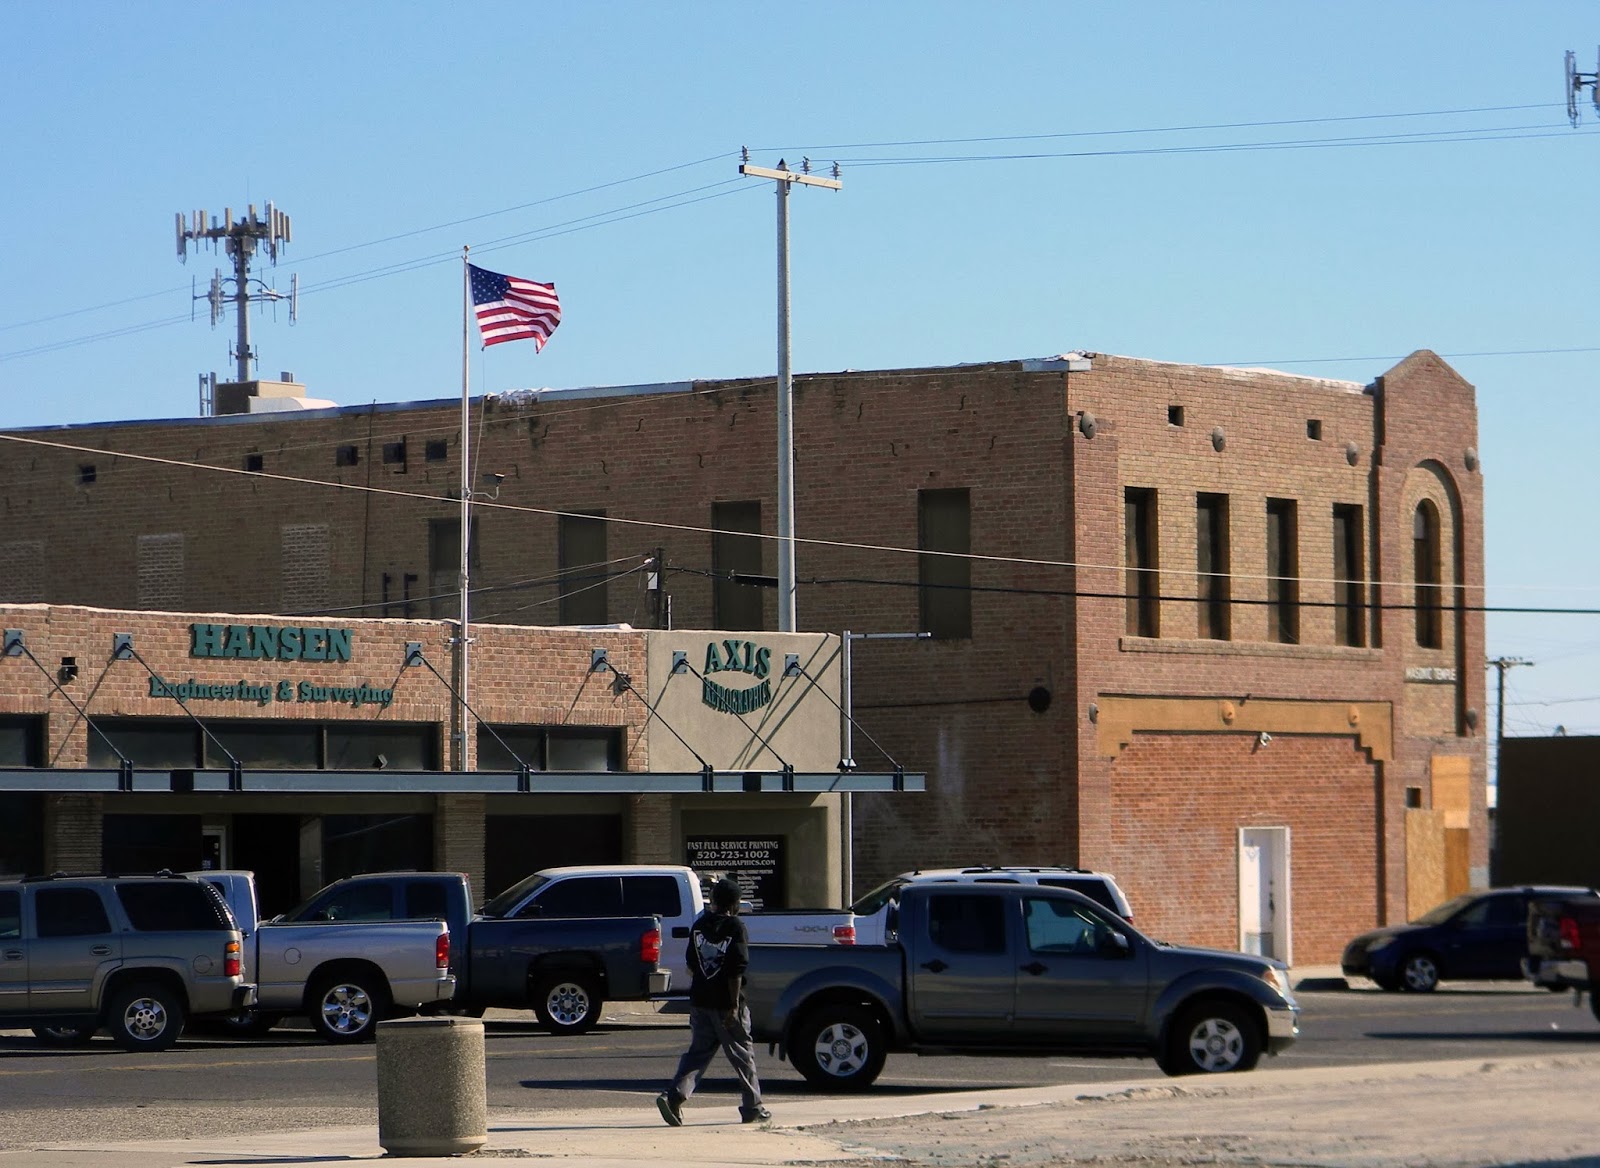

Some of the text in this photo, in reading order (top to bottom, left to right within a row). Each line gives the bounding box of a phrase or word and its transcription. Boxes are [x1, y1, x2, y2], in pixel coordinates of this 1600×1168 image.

[191, 623, 353, 662] HANSEN
[704, 640, 772, 679] AXIS
[149, 675, 394, 708] Engineering & Surveying
[687, 841, 779, 850] FAST FULL SERVICE PRINTING
[697, 850, 770, 859] 520-723-1002
[691, 859, 776, 867] AXISREPROGRAPHICS.COM
